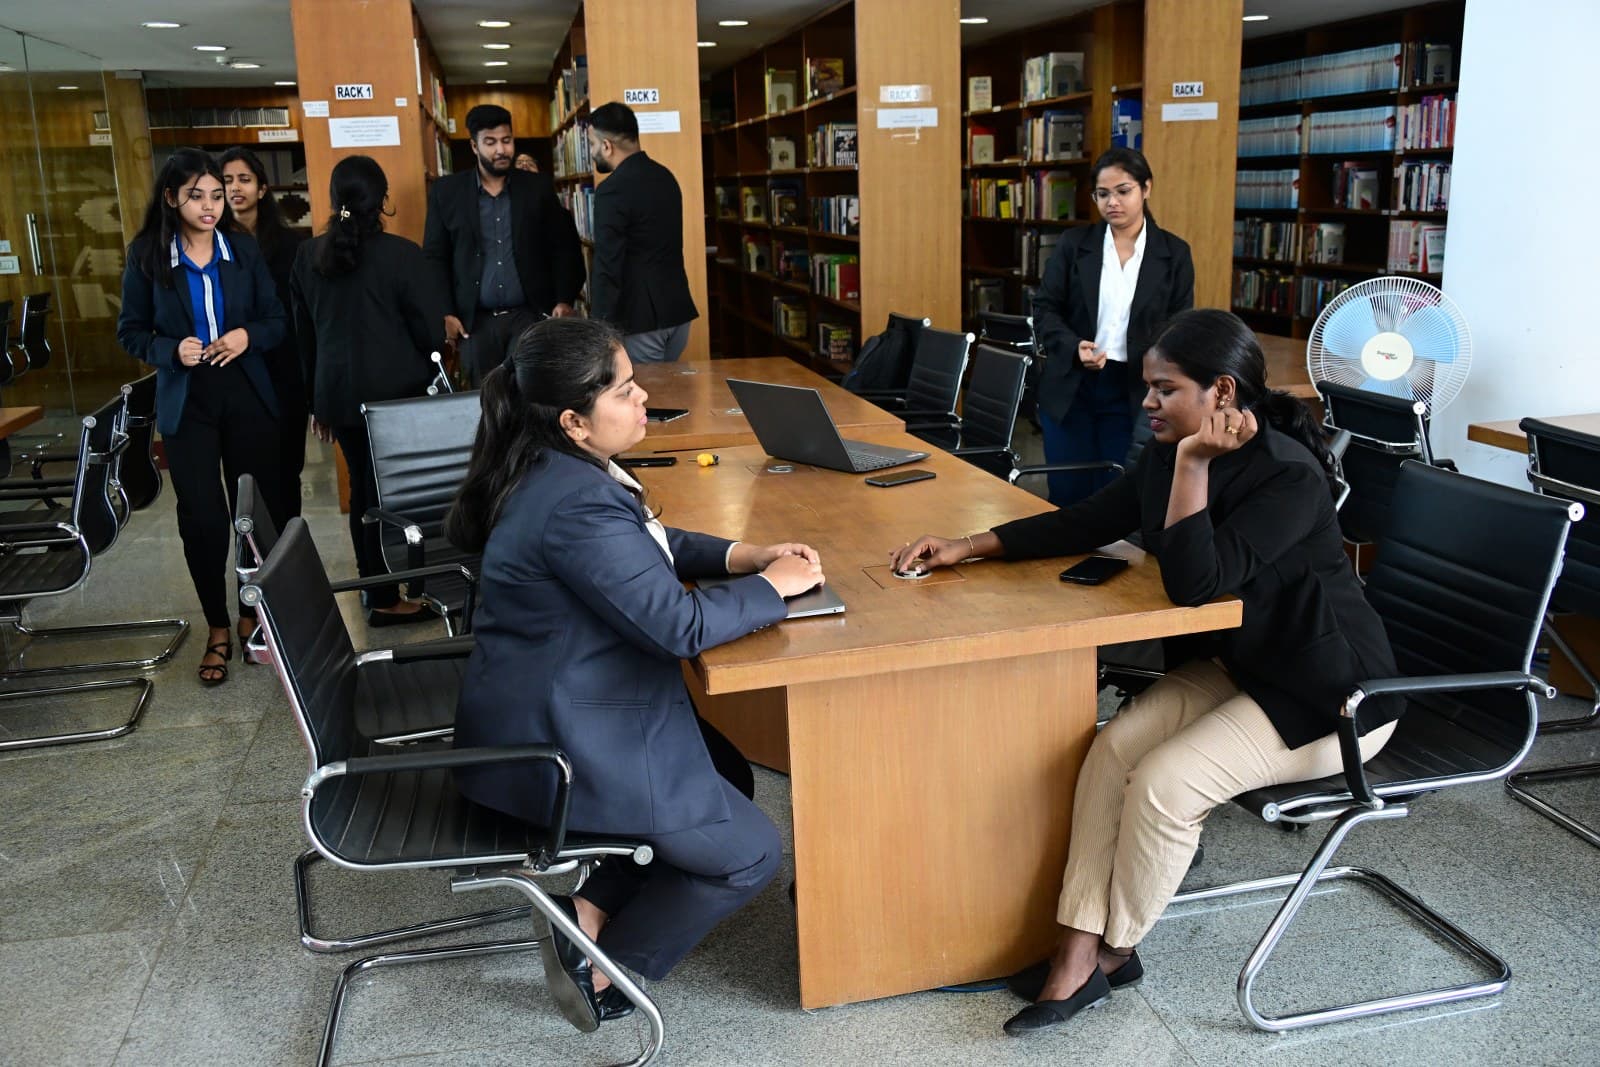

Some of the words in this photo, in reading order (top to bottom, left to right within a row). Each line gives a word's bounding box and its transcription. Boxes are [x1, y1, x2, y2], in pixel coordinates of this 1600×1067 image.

[337, 86, 364, 98] RACK
[366, 86, 371, 98] 1
[889, 88, 912, 99] RACK
[914, 87, 920, 99] 3
[1175, 84, 1195, 95] RACK
[1197, 84, 1202, 94] 4
[625, 90, 649, 102] RACK
[652, 90, 657, 101] 2
